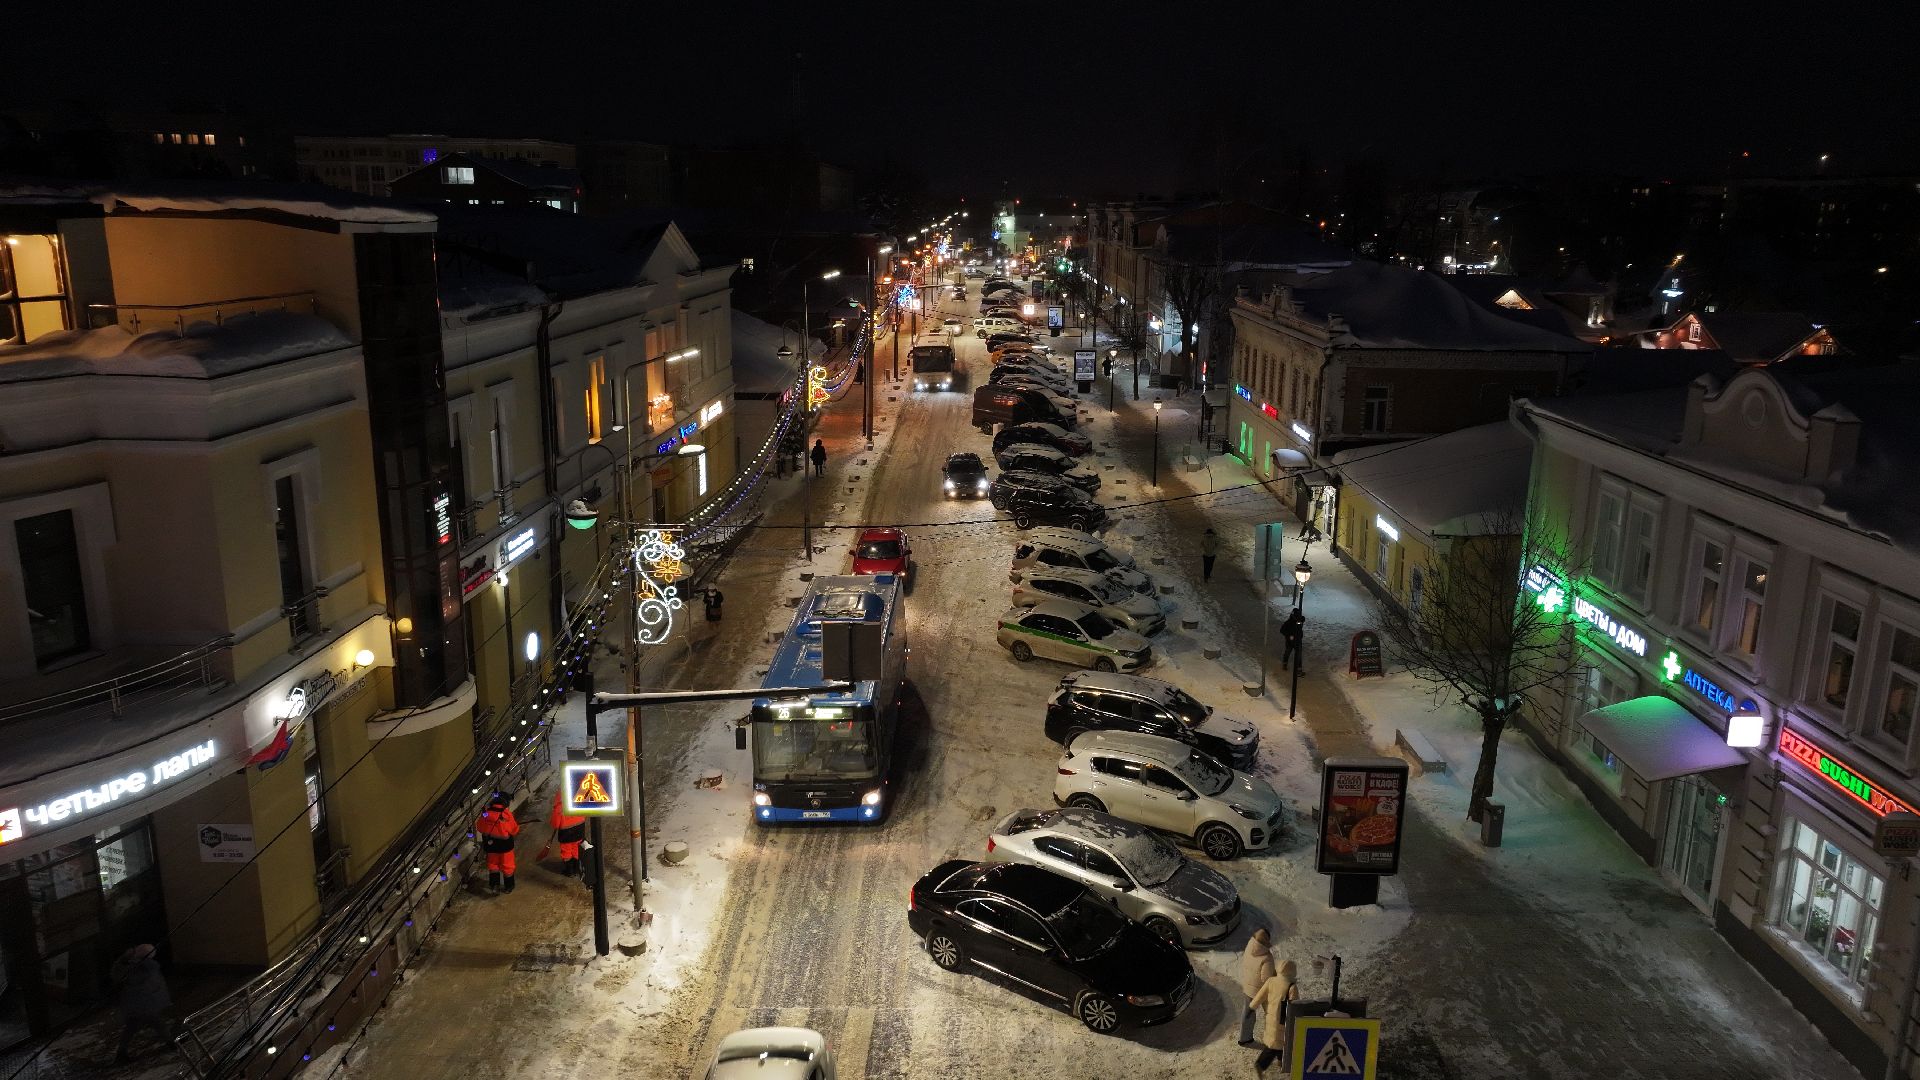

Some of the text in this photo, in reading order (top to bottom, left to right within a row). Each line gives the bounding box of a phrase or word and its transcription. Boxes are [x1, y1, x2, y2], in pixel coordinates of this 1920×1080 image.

[1575, 597, 1610, 631] ЦВЕТЫ
[1616, 625, 1646, 657] ДОМ
[1684, 668, 1735, 713] АПТЕКА
